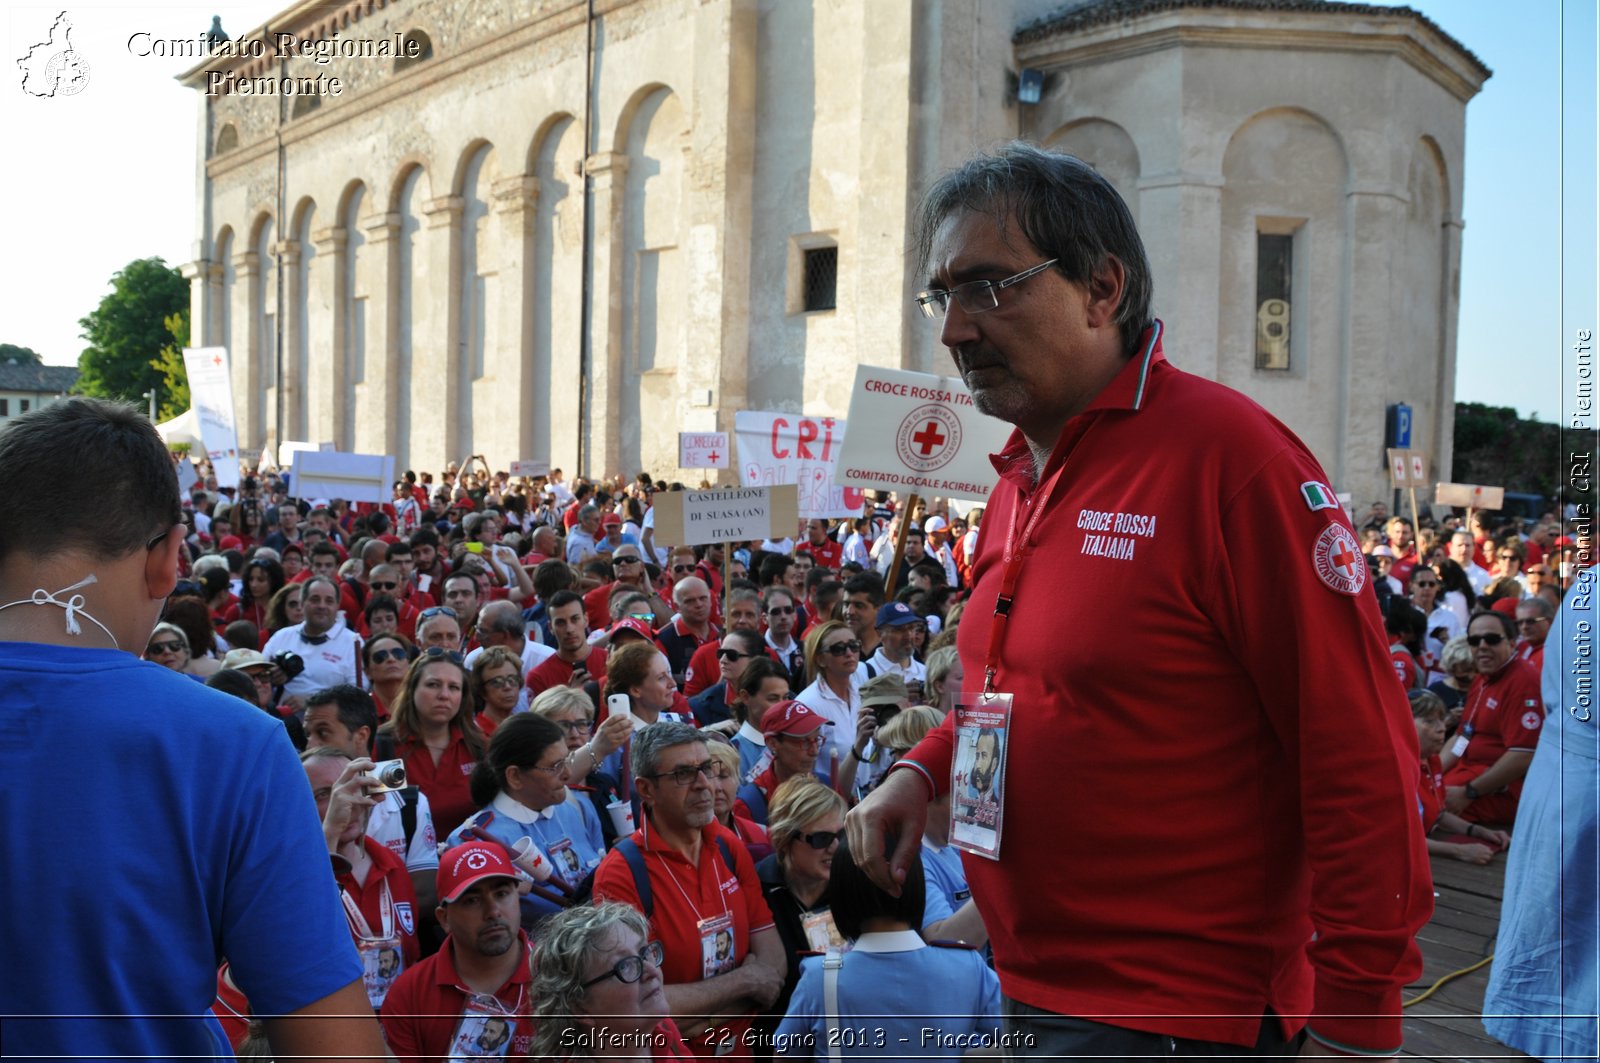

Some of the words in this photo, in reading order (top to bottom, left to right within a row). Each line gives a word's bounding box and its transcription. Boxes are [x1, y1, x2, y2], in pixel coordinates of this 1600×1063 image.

[865, 379, 907, 396] CROCE
[910, 386, 951, 402] ROSSA
[955, 393, 973, 407] ITA
[1400, 412, 1409, 443] P
[846, 468, 899, 484] COMITATO
[901, 475, 940, 489] LOCALE
[941, 480, 989, 495] ACIREALE
[688, 488, 765, 503] CASTELLEONE
[690, 510, 702, 521] DI
[706, 509, 741, 520] SUASA
[742, 508, 765, 520] (AN)
[1077, 509, 1115, 531] CROCE
[1113, 512, 1157, 537] ROSSA
[712, 527, 744, 538] ITALY
[1080, 533, 1136, 561] ITALIANA
